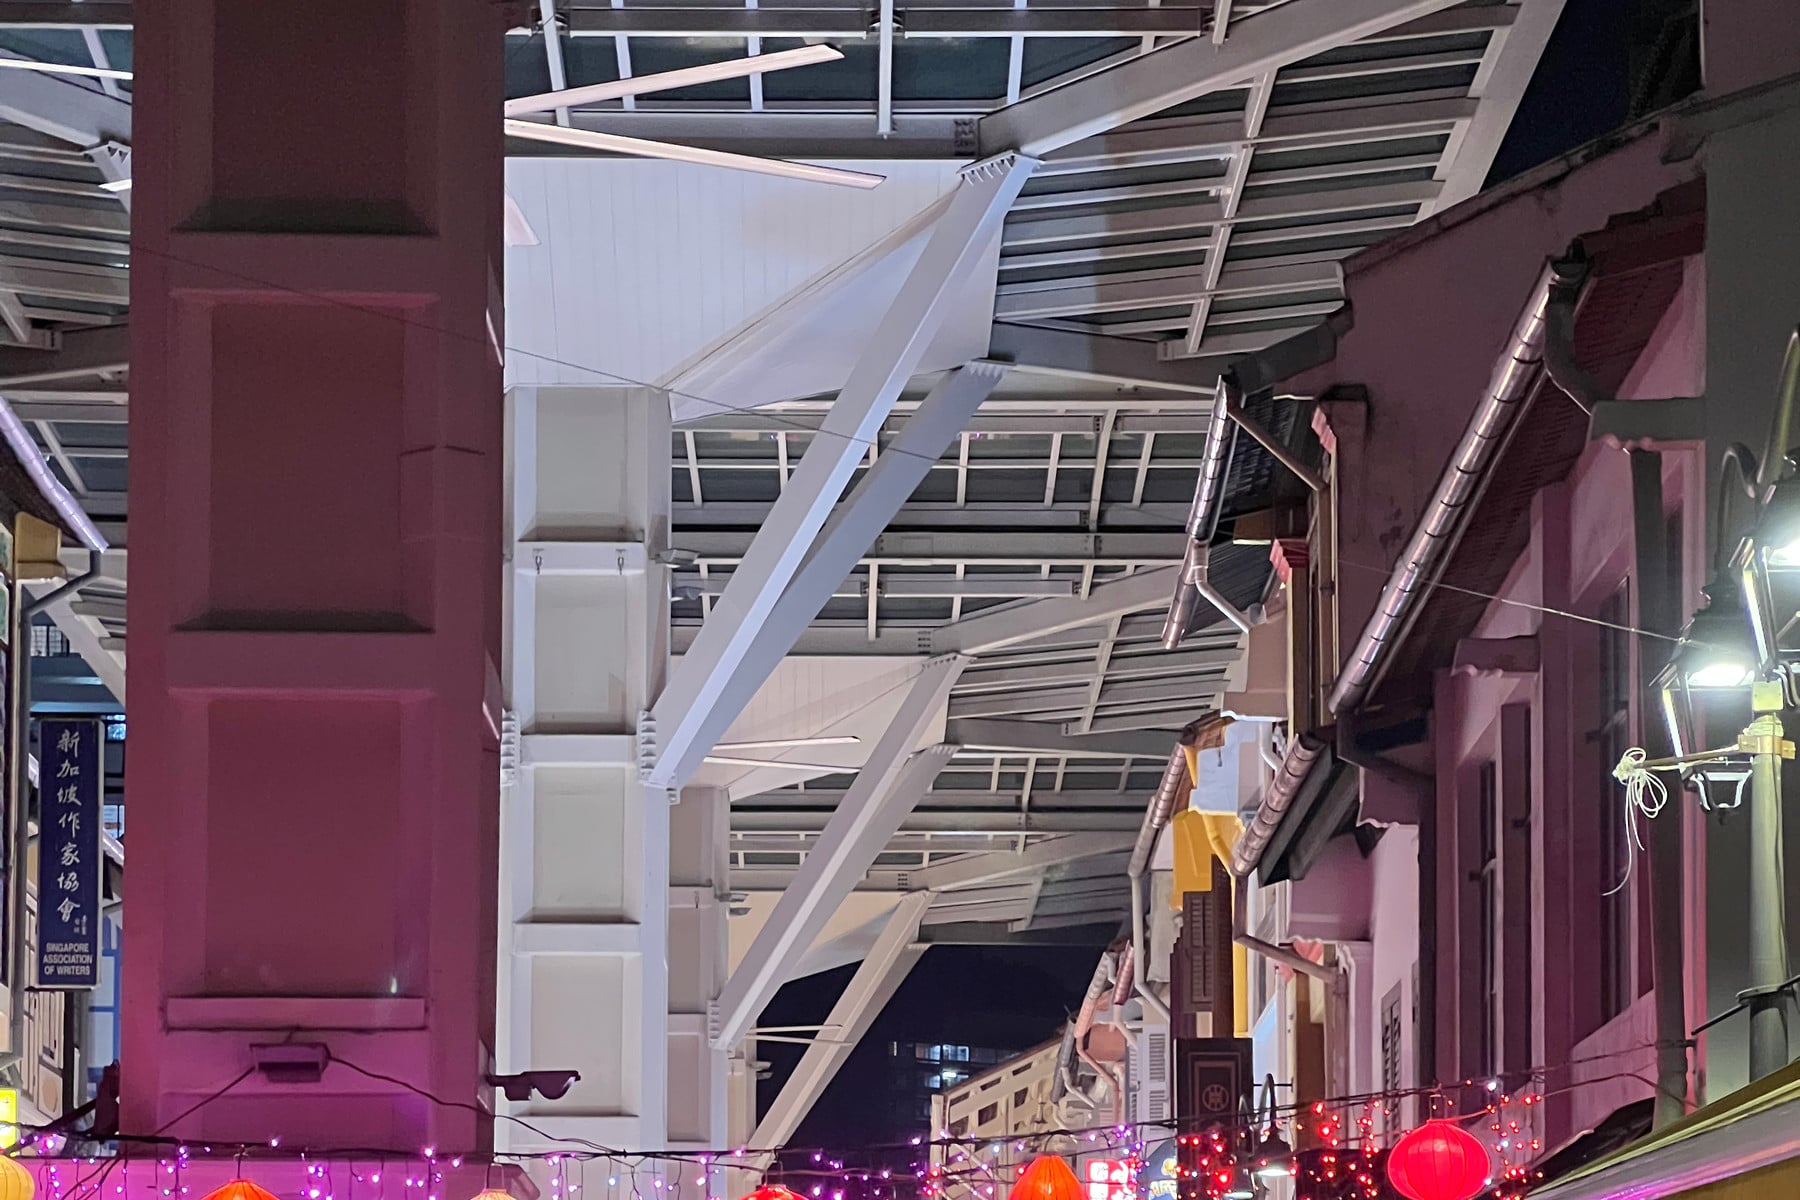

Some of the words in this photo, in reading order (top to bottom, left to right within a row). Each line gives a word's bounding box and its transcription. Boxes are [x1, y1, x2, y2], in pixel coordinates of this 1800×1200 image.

[57, 729, 82, 922] 新加坡作家協會
[46, 942, 89, 953] SINGAPORE
[43, 954, 93, 964] ASSOCIATION
[44, 965, 55, 975] OF
[56, 965, 90, 975] WRITERS
